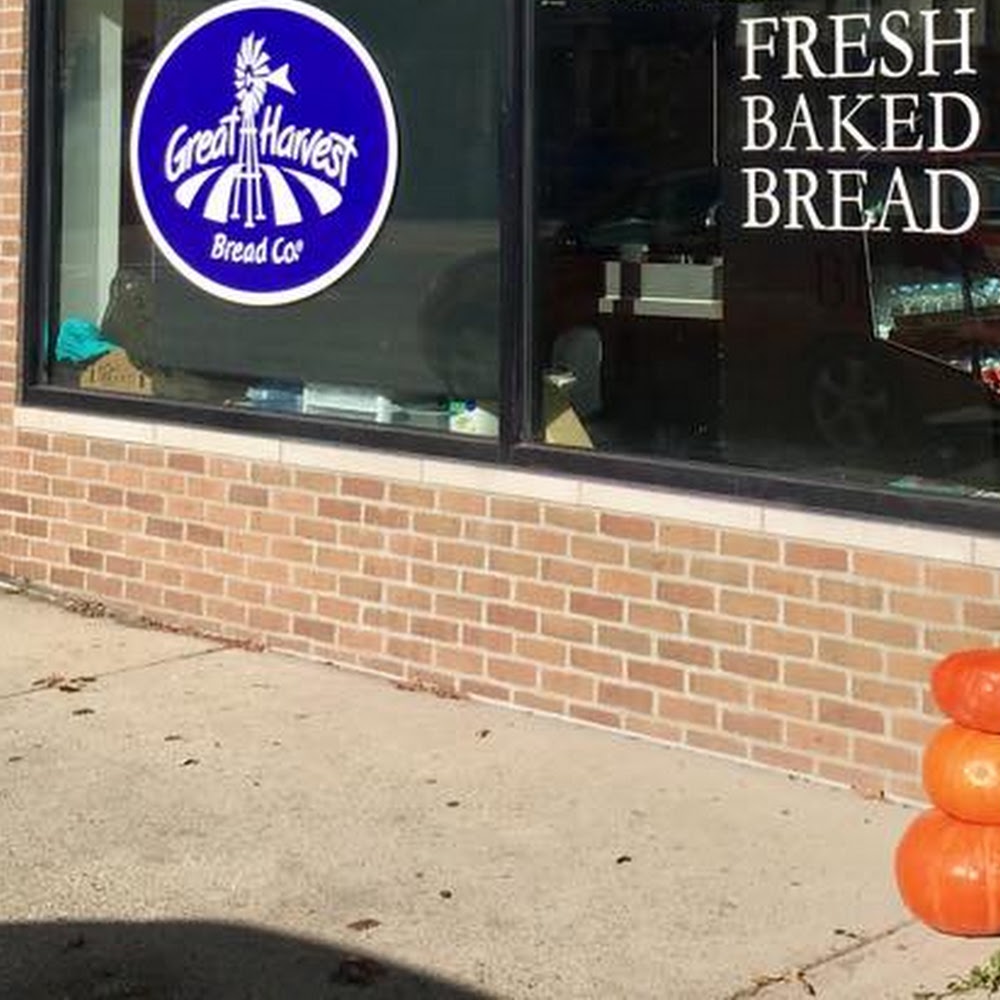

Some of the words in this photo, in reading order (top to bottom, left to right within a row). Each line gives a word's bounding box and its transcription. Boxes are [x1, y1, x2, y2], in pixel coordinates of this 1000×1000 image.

[740, 7, 978, 81] FRESH
[164, 105, 241, 182] Great
[259, 104, 358, 187] Harvest
[740, 91, 981, 153] BAKED
[740, 166, 981, 235] BREAD
[210, 232, 268, 263] Bread
